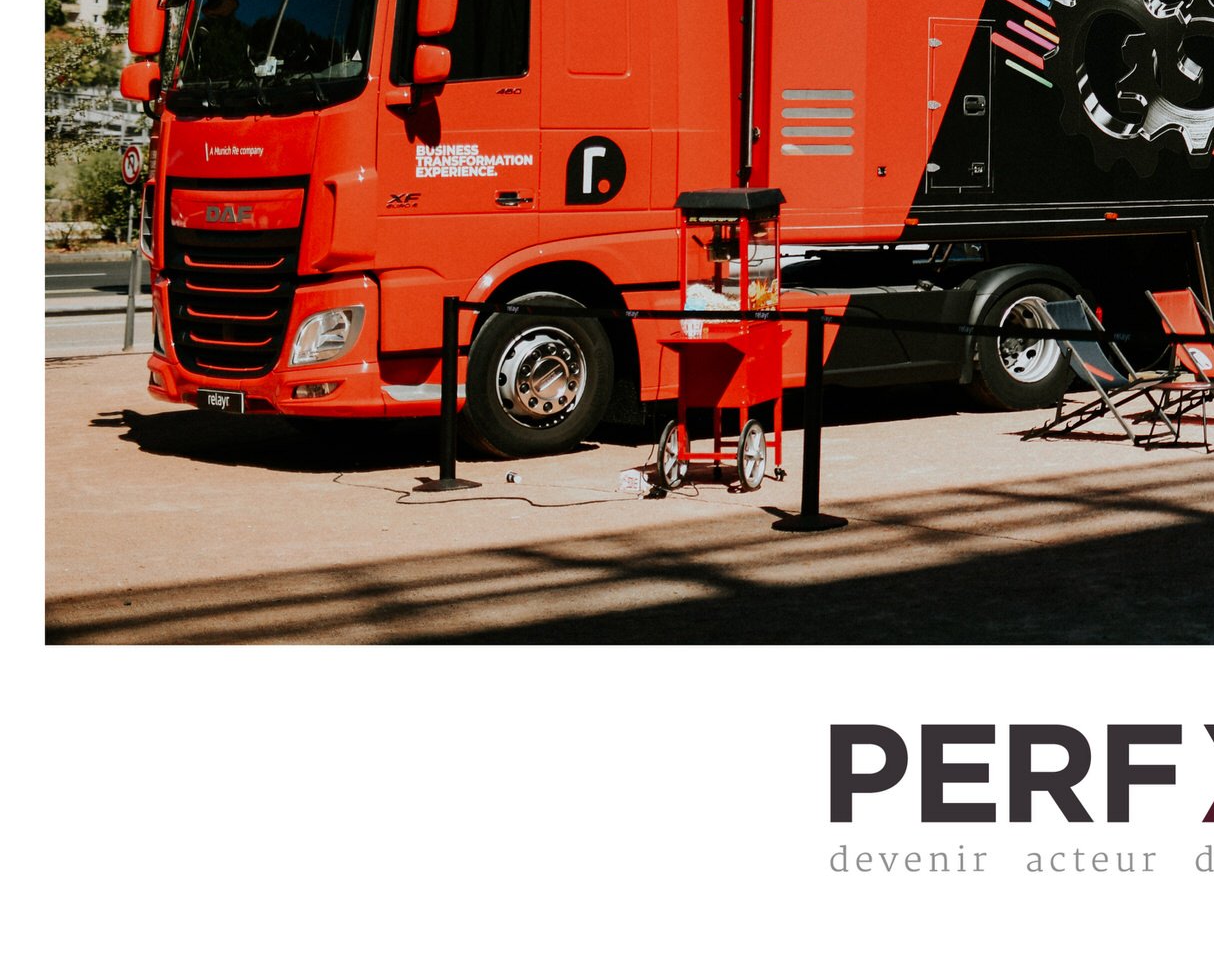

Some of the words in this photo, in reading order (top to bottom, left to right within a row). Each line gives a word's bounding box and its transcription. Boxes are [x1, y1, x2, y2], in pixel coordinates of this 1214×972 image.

[209, 147, 214, 155] A
[214, 146, 231, 155] Munich
[232, 146, 239, 155] Re
[240, 147, 264, 157] company
[416, 145, 478, 156] BUSINESS
[416, 155, 533, 166] TRANSFORMATION
[416, 166, 498, 178] EXPERIENCE.
[206, 205, 253, 223] DAF
[208, 392, 230, 410] relayr
